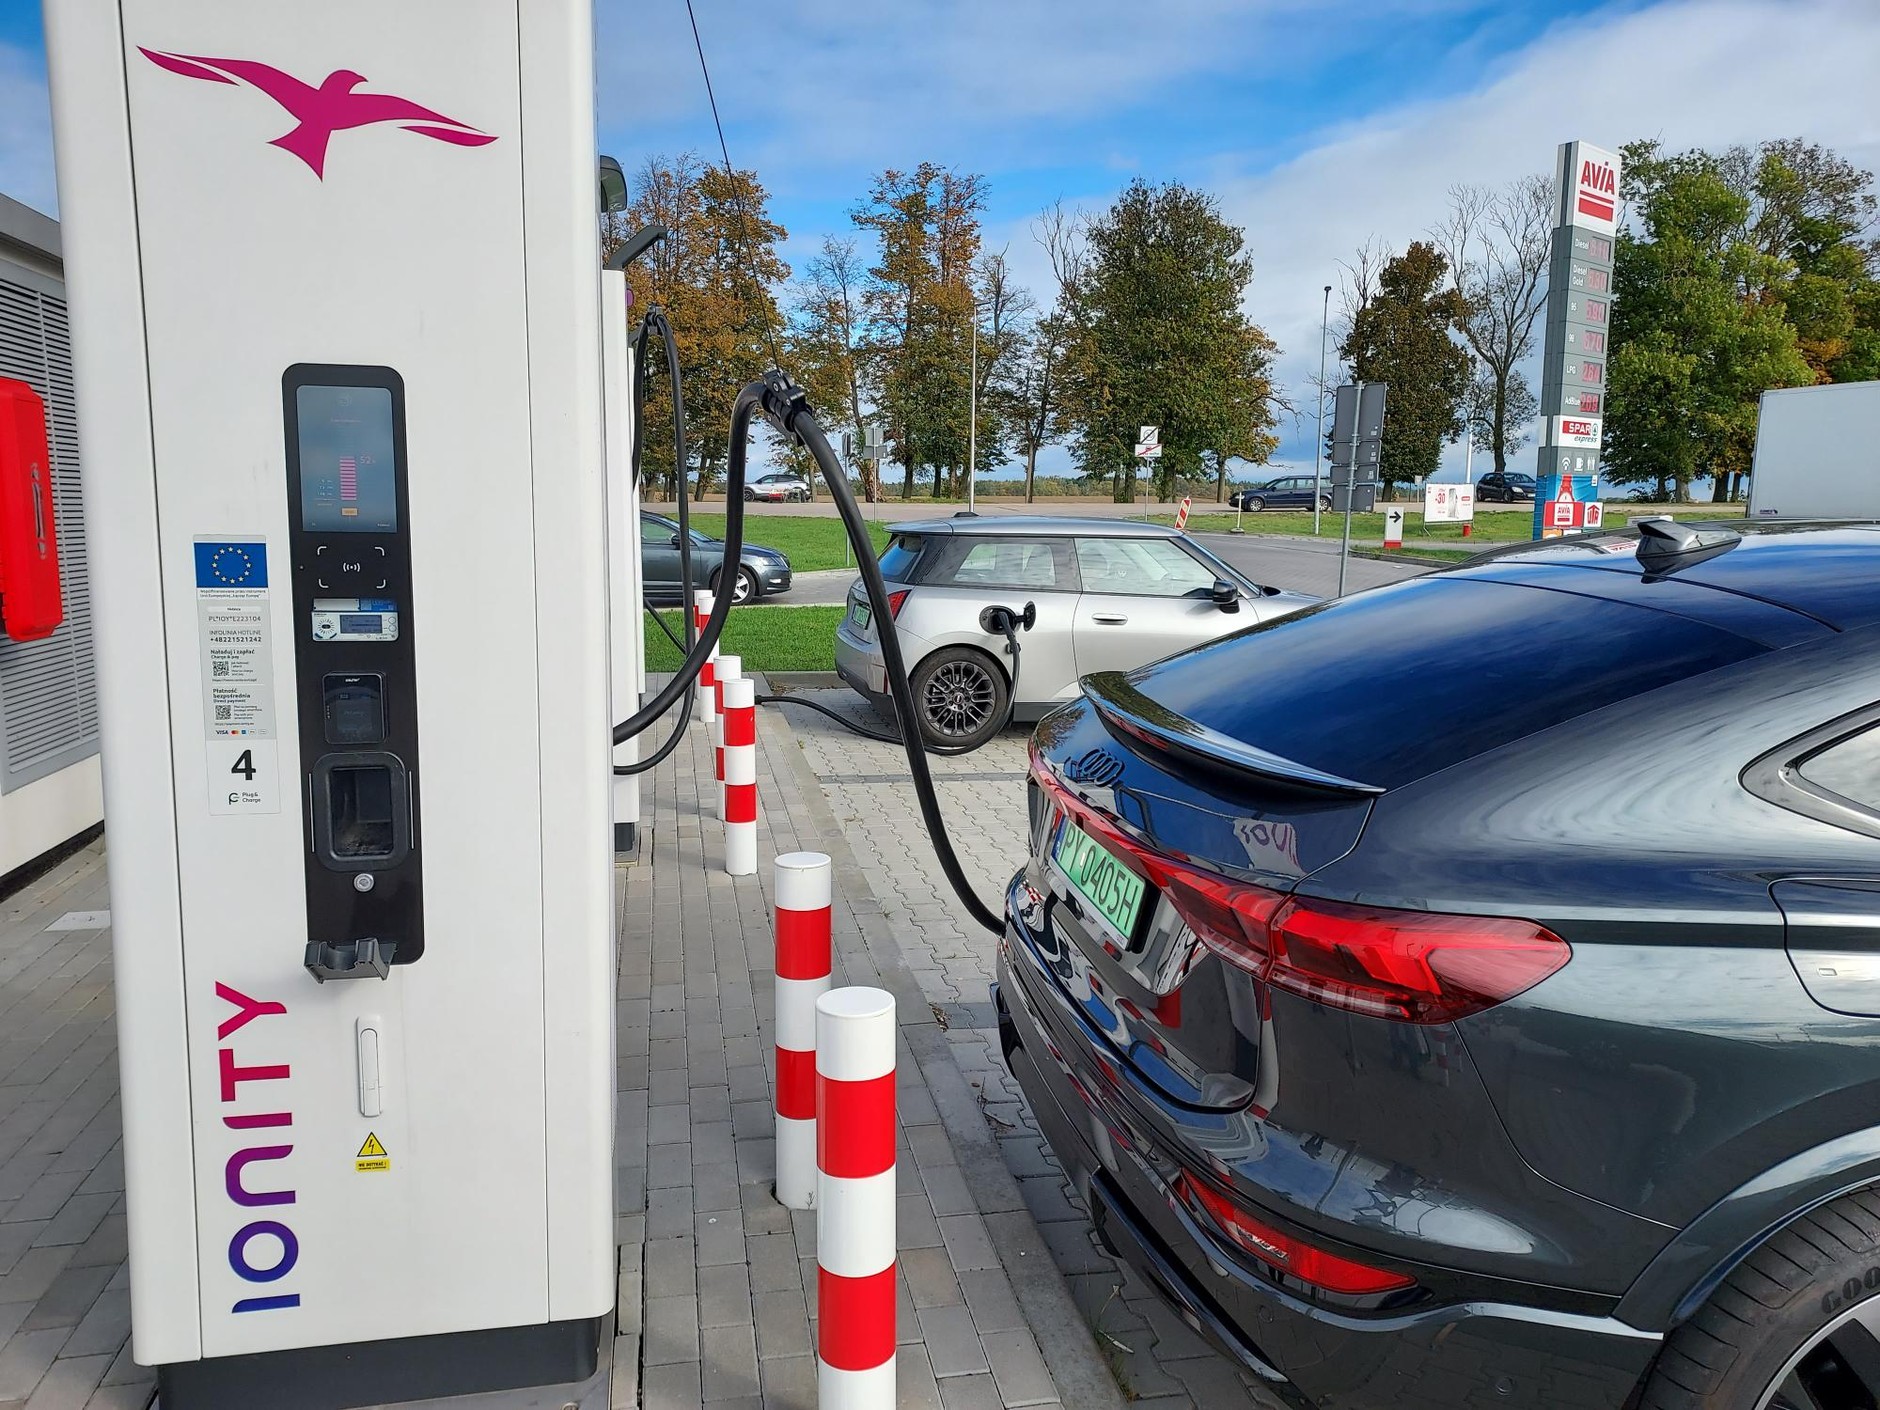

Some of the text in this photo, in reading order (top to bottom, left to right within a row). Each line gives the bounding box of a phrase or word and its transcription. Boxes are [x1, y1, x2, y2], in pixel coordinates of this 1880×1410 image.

[1575, 238, 1589, 250] Diesel
[1573, 264, 1588, 276] Diesel
[1572, 276, 1584, 287] Gold
[1566, 365, 1576, 374] LPG
[1569, 422, 1591, 434] SPAR
[1574, 435, 1598, 443] express
[231, 749, 256, 781] 4
[1060, 822, 1138, 931] PY 0405H
[214, 981, 300, 1314] IONITY
